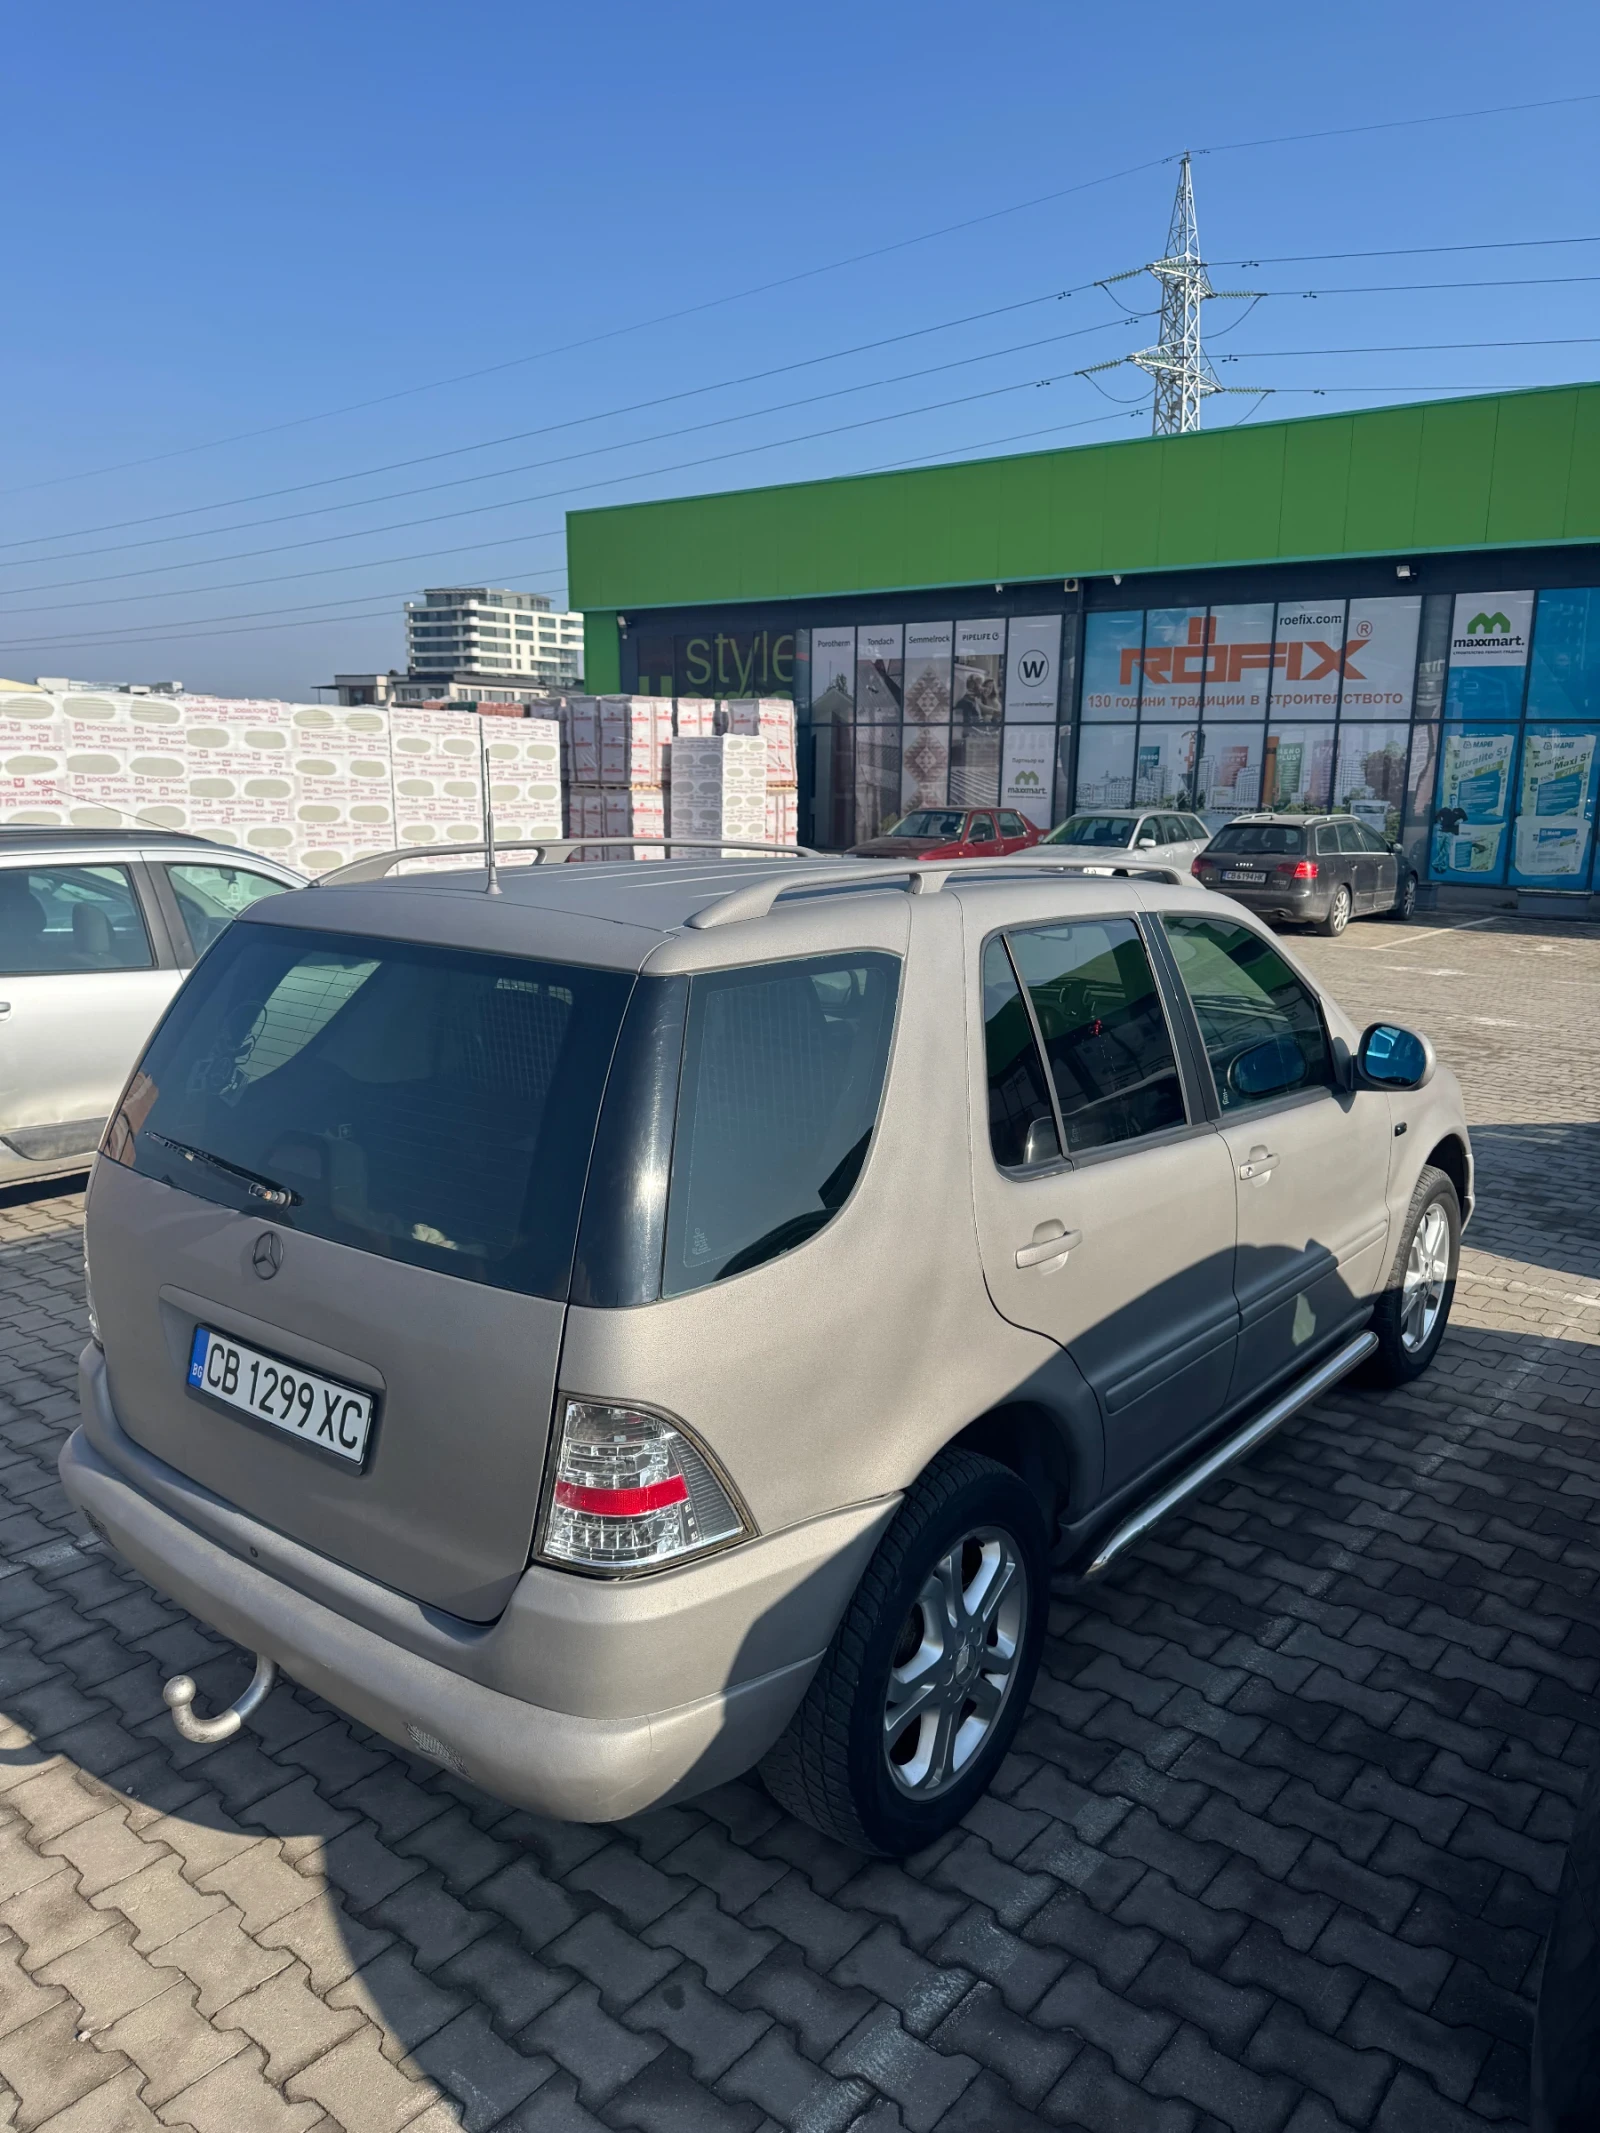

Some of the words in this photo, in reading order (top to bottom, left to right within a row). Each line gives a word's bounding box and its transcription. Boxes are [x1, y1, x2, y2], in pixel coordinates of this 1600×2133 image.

[1279, 614, 1342, 626] roefix.com
[817, 640, 851, 648] Porotherm
[867, 637, 894, 646] Tondach
[908, 635, 950, 644] Semmelrock
[962, 633, 991, 641] PIPELIFE
[686, 630, 793, 696] style
[1022, 660, 1046, 678] W
[1088, 695, 1112, 708] 130
[1115, 696, 1165, 709] години
[1170, 695, 1246, 709] традиции
[1250, 695, 1260, 705] в
[1454, 752, 1494, 769] Ultralite
[1554, 756, 1578, 770] Maxi
[1237, 871, 1254, 881] 6194
[191, 1362, 203, 1378] BG
[206, 1343, 241, 1396] CB
[249, 1360, 315, 1429] 1299
[316, 1389, 363, 1450] XC
